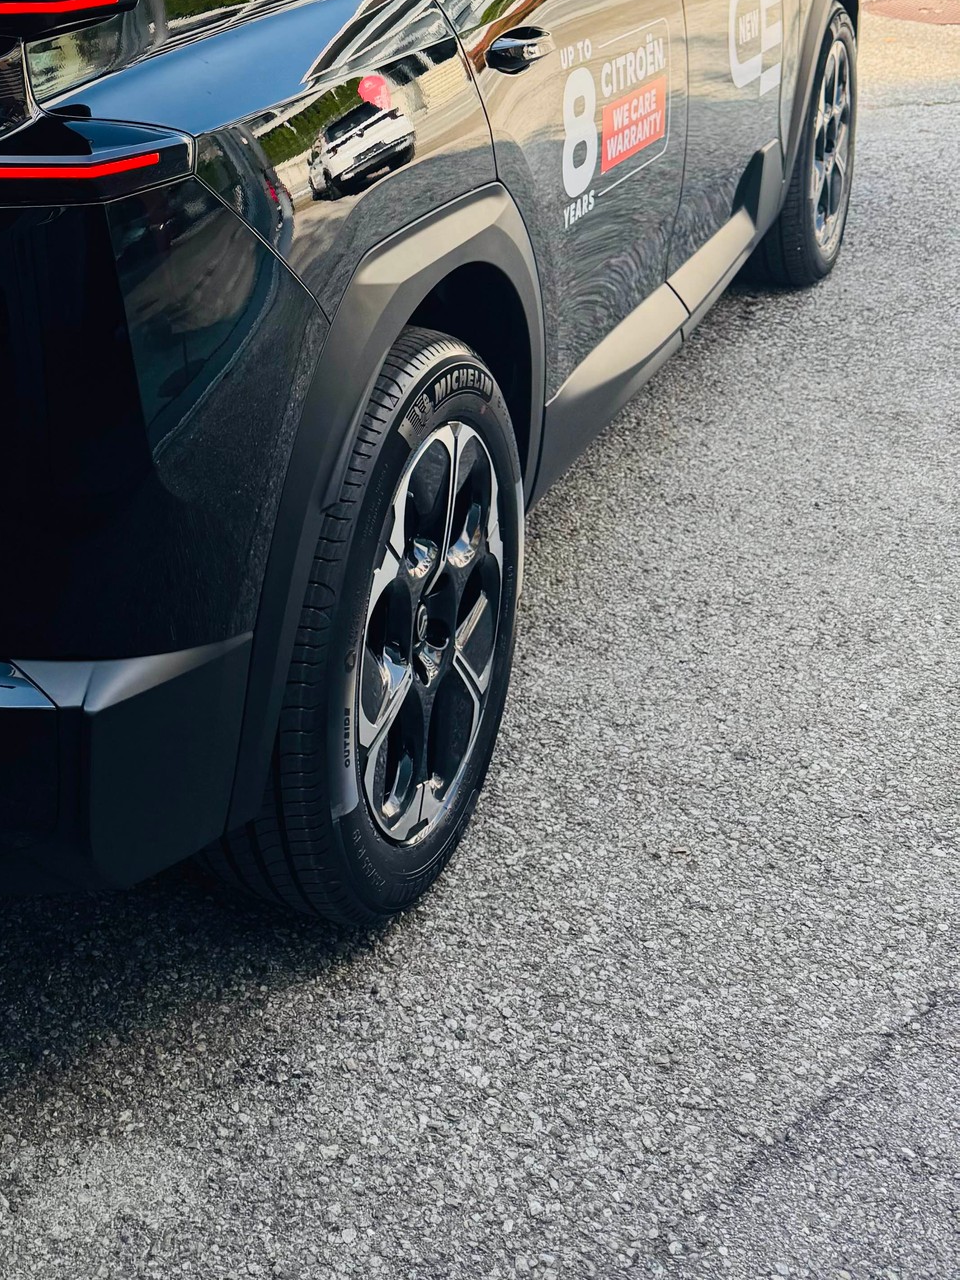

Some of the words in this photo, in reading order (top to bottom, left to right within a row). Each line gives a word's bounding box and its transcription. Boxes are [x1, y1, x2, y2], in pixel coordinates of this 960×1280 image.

[739, 8, 759, 45] NEW
[560, 46, 574, 69] UP
[577, 38, 592, 62] TO
[613, 103, 630, 131] WE
[630, 88, 657, 121] CARE
[563, 67, 598, 198] 8
[606, 110, 662, 162] WARRANTY
[563, 190, 595, 229] YEARS
[434, 368, 494, 405] MICHELIN
